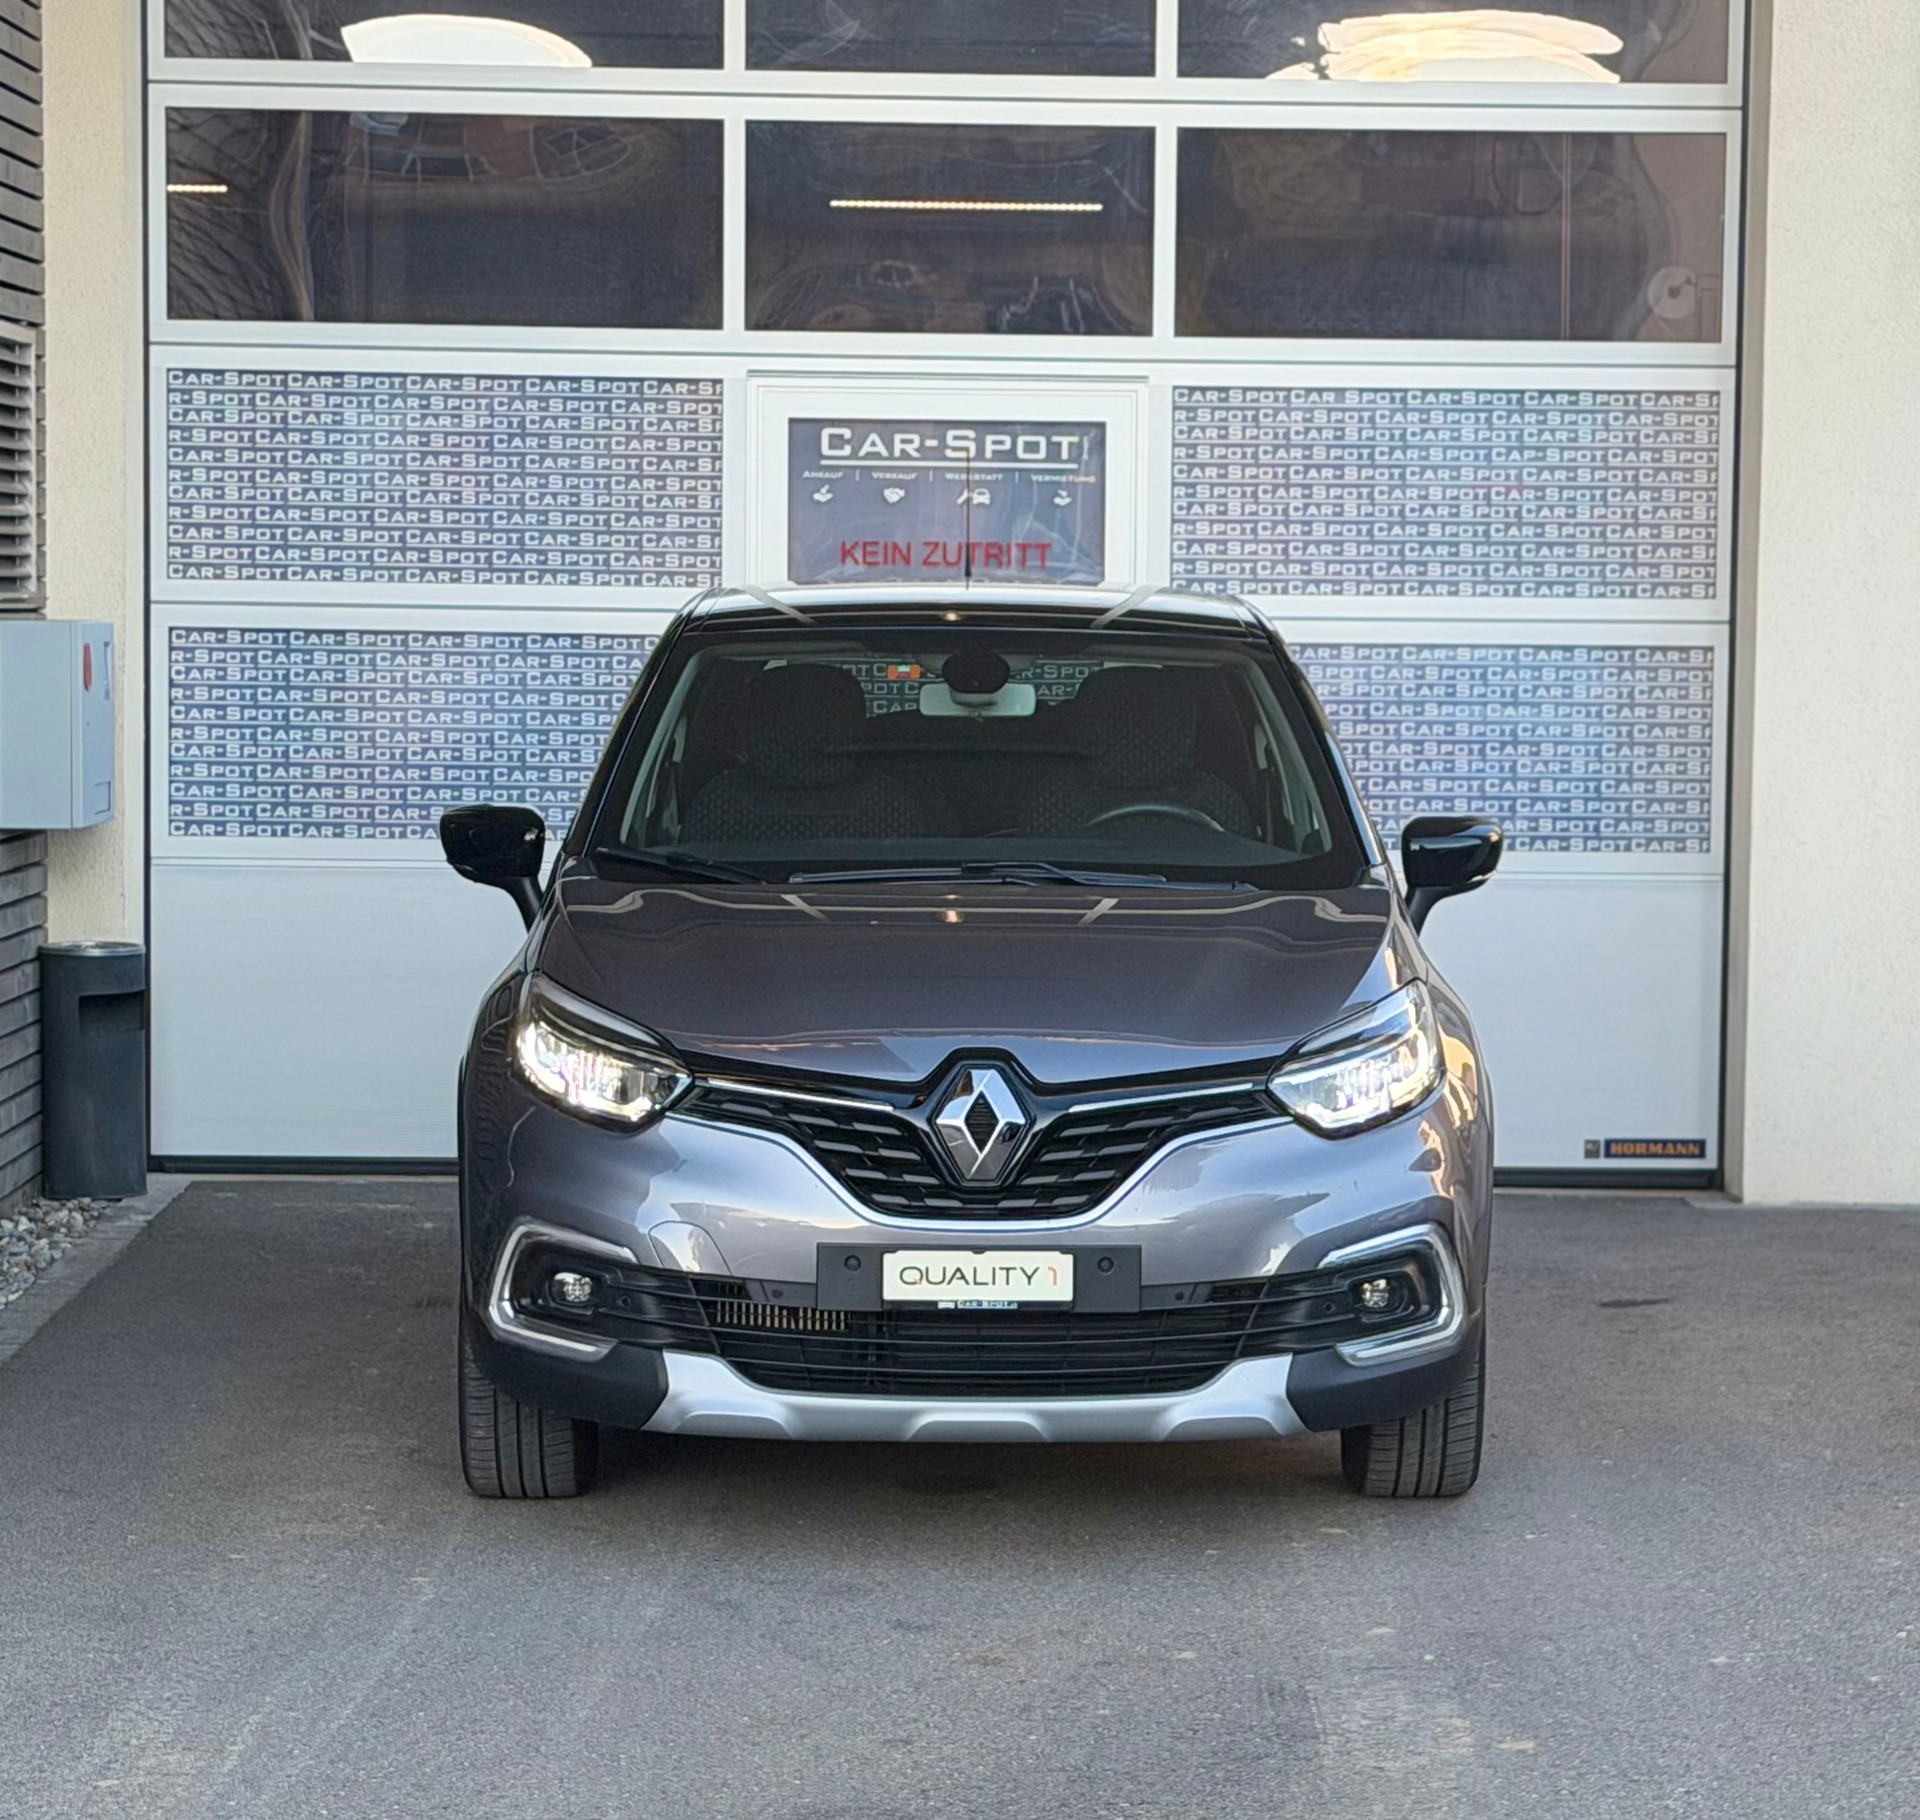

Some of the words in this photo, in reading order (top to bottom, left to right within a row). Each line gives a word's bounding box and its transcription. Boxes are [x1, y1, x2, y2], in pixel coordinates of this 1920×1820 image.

[820, 427, 1079, 460] CAR-SPOT
[839, 541, 912, 566] KEIN
[921, 541, 1053, 567] ZUTRITT
[899, 1266, 1040, 1286] QUALITY
